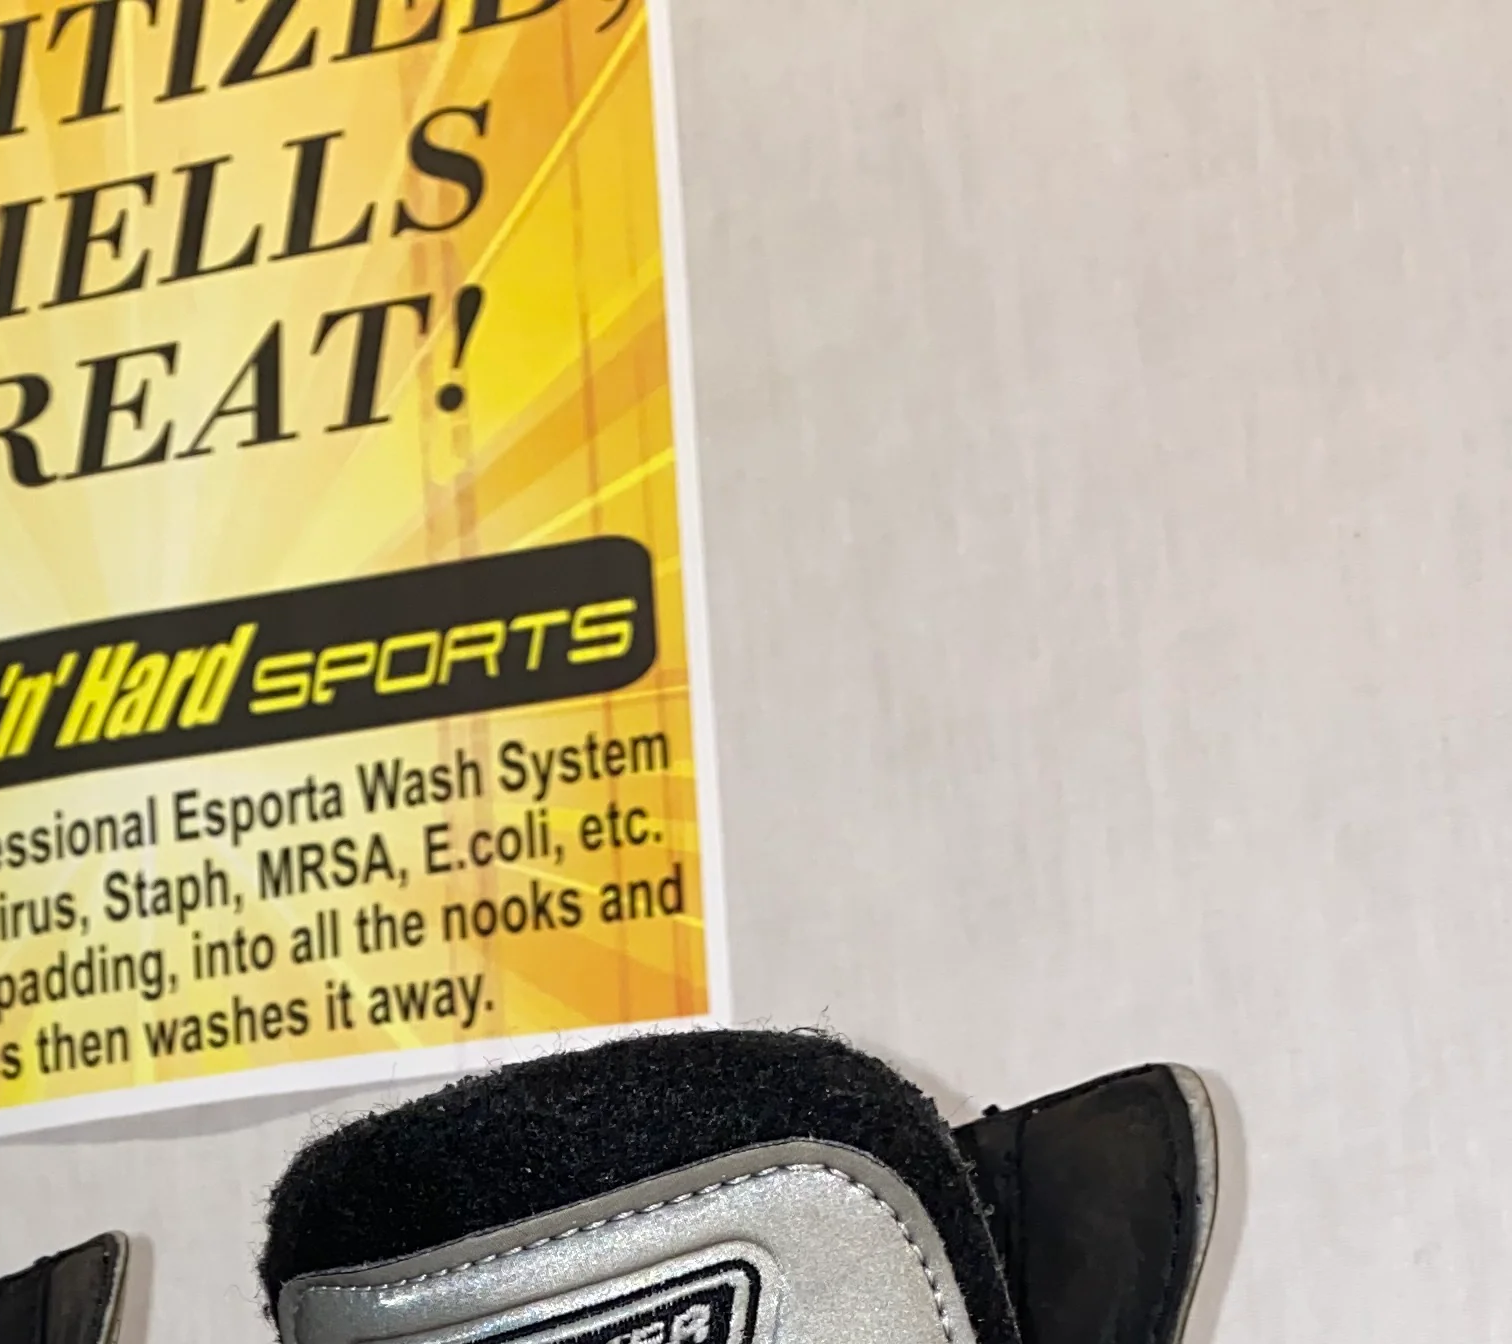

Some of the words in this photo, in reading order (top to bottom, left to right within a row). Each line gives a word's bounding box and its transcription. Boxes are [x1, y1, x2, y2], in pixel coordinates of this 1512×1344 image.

[55, 622, 259, 749] Hard
[249, 597, 638, 716] SPORTS
[174, 775, 343, 847] Esporta
[356, 749, 482, 812] Wash
[498, 731, 670, 801] System
[102, 860, 243, 925] Staph,
[257, 833, 408, 902] MRSA,
[423, 809, 564, 875] E.coli,
[579, 805, 662, 852] etc.
[193, 929, 276, 981] into
[290, 909, 340, 966] all
[357, 903, 427, 956] the
[442, 880, 583, 943] nooks
[599, 863, 685, 923] and
[35, 1022, 129, 1075] then
[143, 997, 310, 1059] washes
[326, 982, 354, 1031] it
[367, 972, 495, 1029] away.
